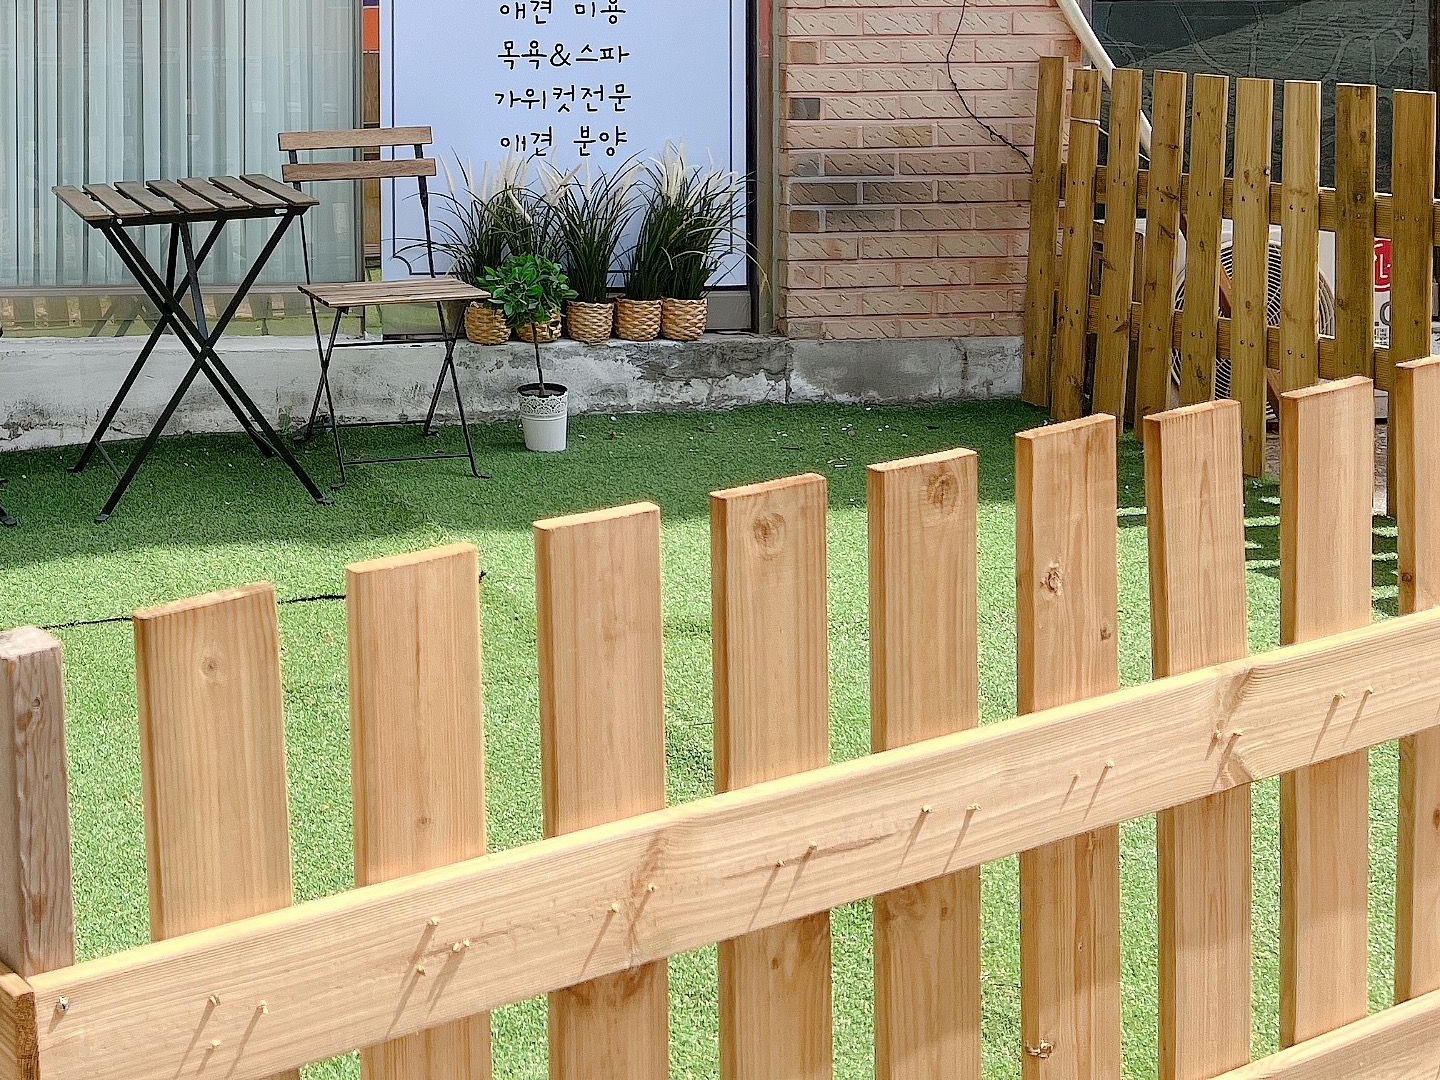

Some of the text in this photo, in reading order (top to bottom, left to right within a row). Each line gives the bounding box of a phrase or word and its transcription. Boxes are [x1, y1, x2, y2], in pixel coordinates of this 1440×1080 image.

[497, 40, 630, 70] 목욕&스파
[495, 83, 632, 113] 가위컷전문
[500, 126, 629, 157] 애견 분양
